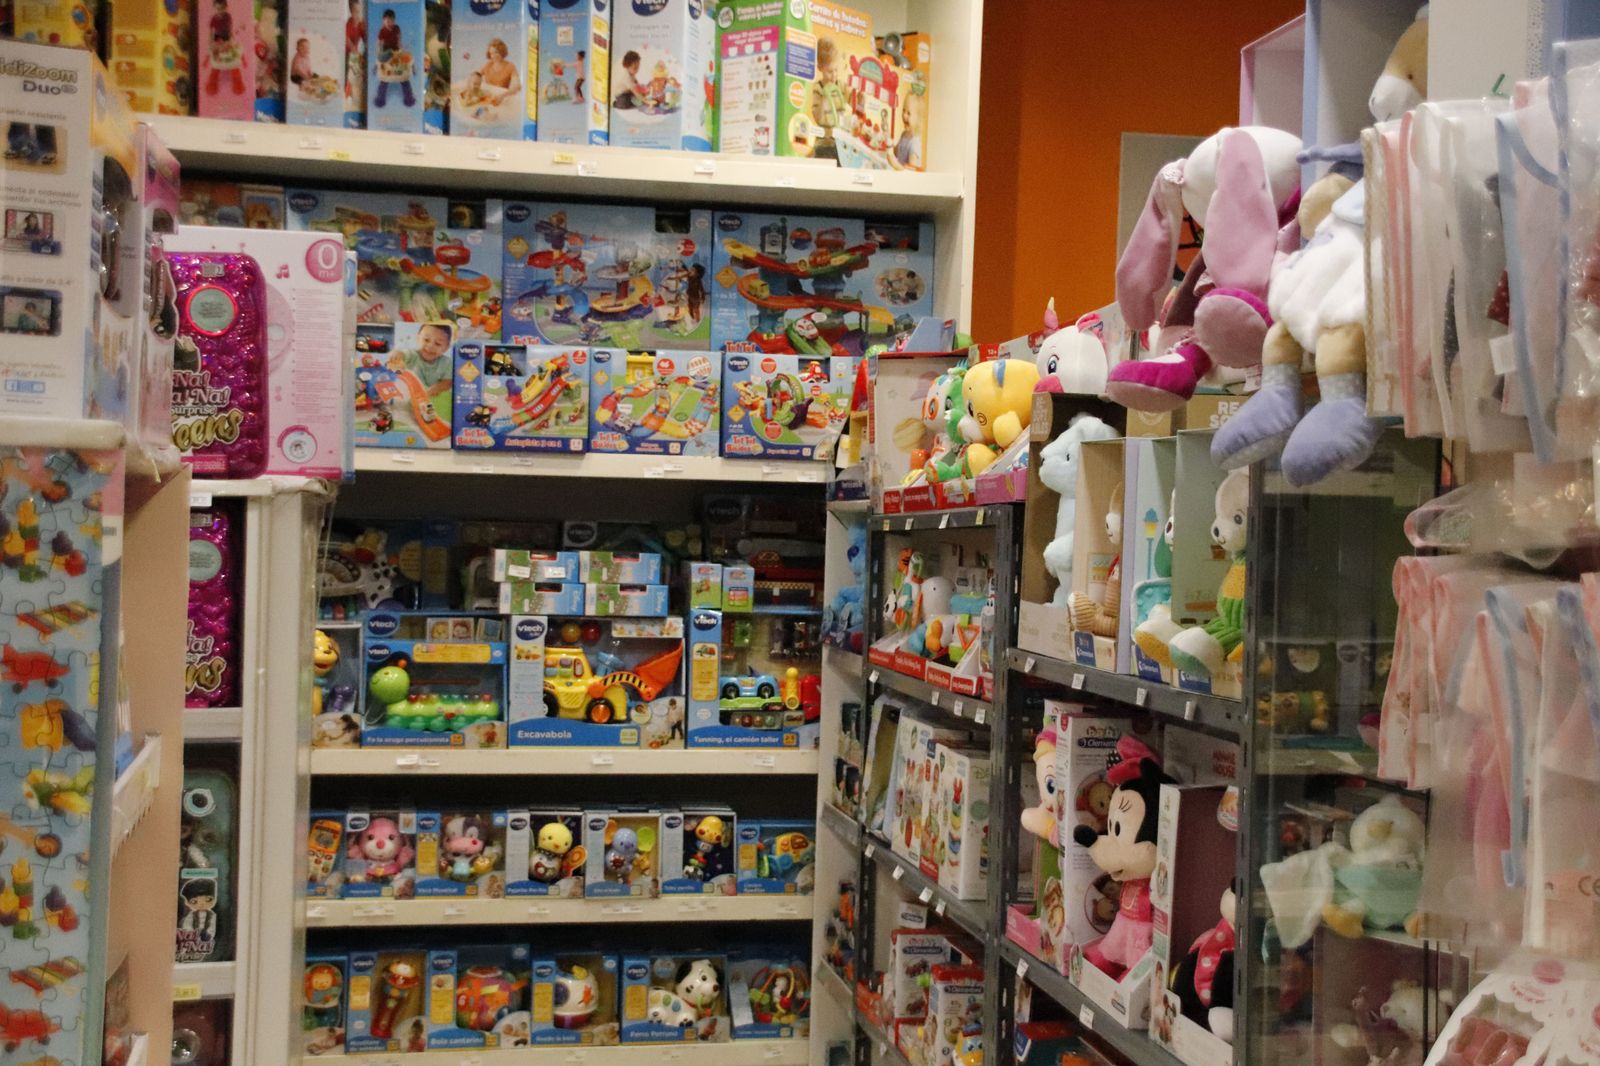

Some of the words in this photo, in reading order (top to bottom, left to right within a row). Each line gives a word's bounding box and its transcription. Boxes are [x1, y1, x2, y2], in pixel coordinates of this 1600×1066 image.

[0, 57, 79, 84] idiZoom
[23, 80, 61, 95] Duo
[172, 389, 189, 404] a!
[191, 387, 230, 405] Na!
[174, 409, 243, 452] eens
[369, 620, 395, 628] vtech
[517, 730, 572, 739] Excavabola
